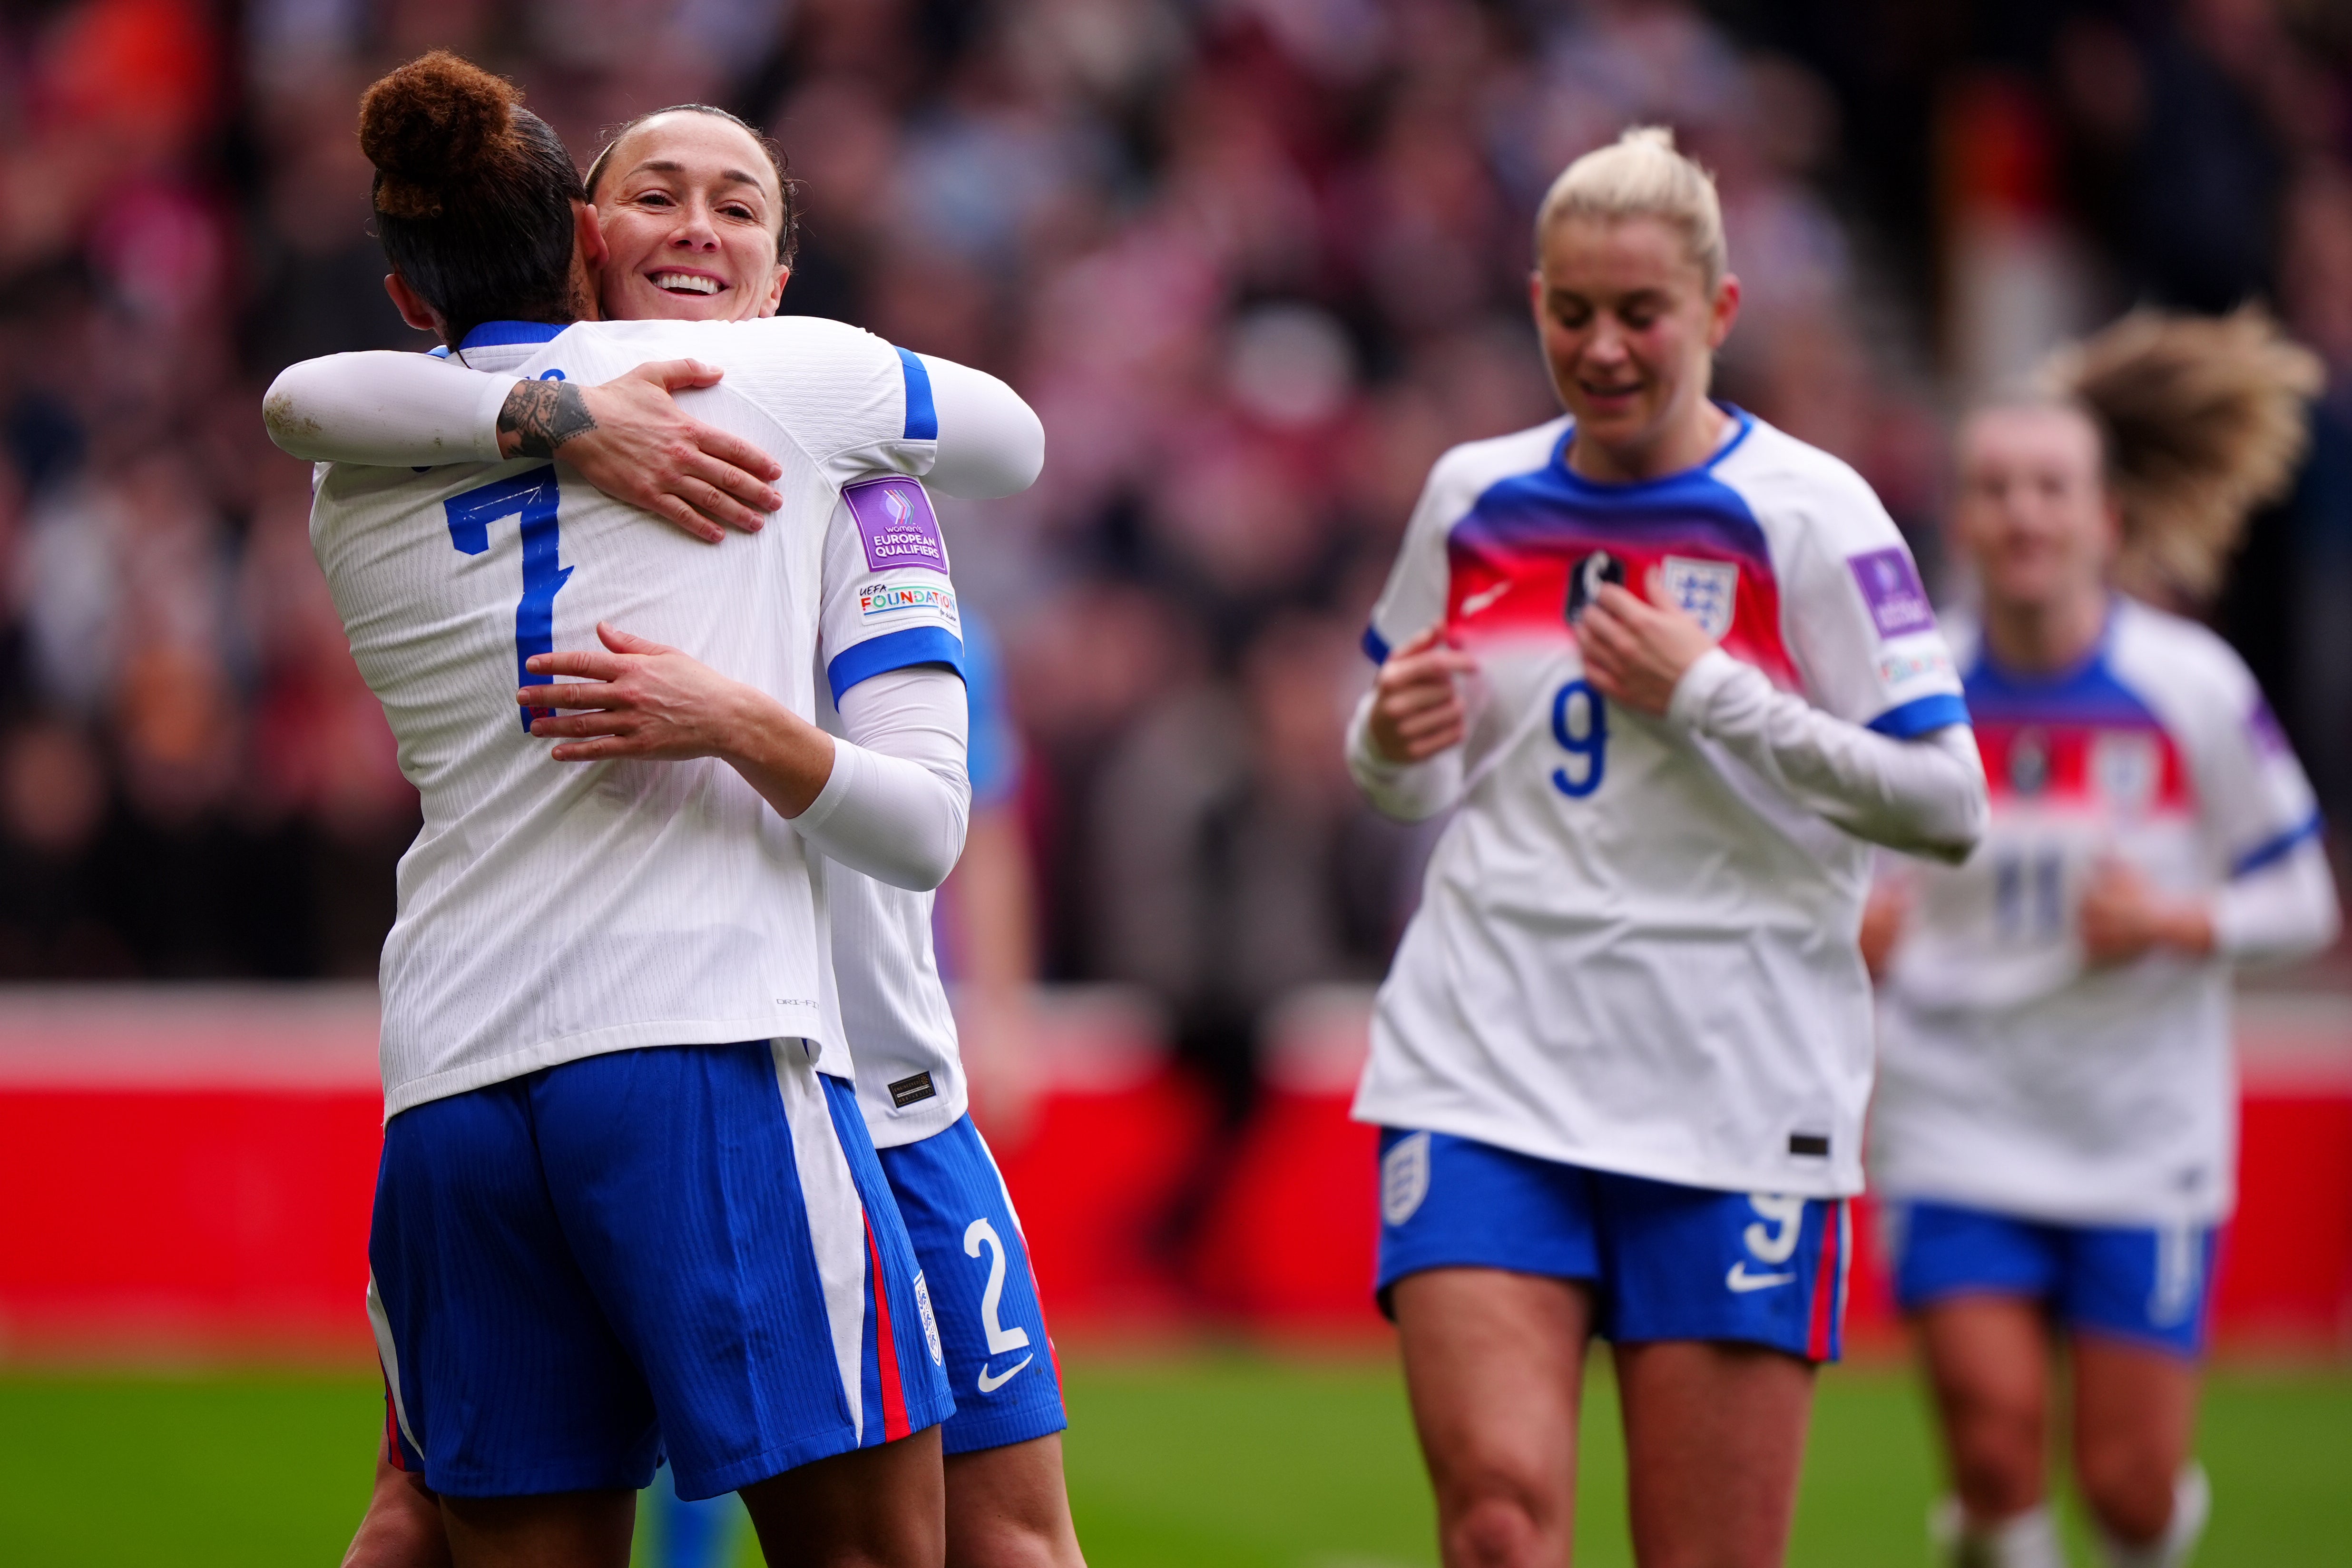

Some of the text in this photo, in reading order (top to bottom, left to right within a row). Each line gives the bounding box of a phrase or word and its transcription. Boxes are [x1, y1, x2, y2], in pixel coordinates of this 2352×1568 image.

[885, 525, 923, 533] women's
[873, 534, 936, 547] EUROPEAN
[875, 544, 939, 559] QUALIFIERS
[443, 463, 575, 733] 7
[860, 584, 887, 596] UEFA
[861, 591, 955, 611] FOUNDATION
[1552, 680, 1606, 797] 9
[964, 1218, 1029, 1355] 2
